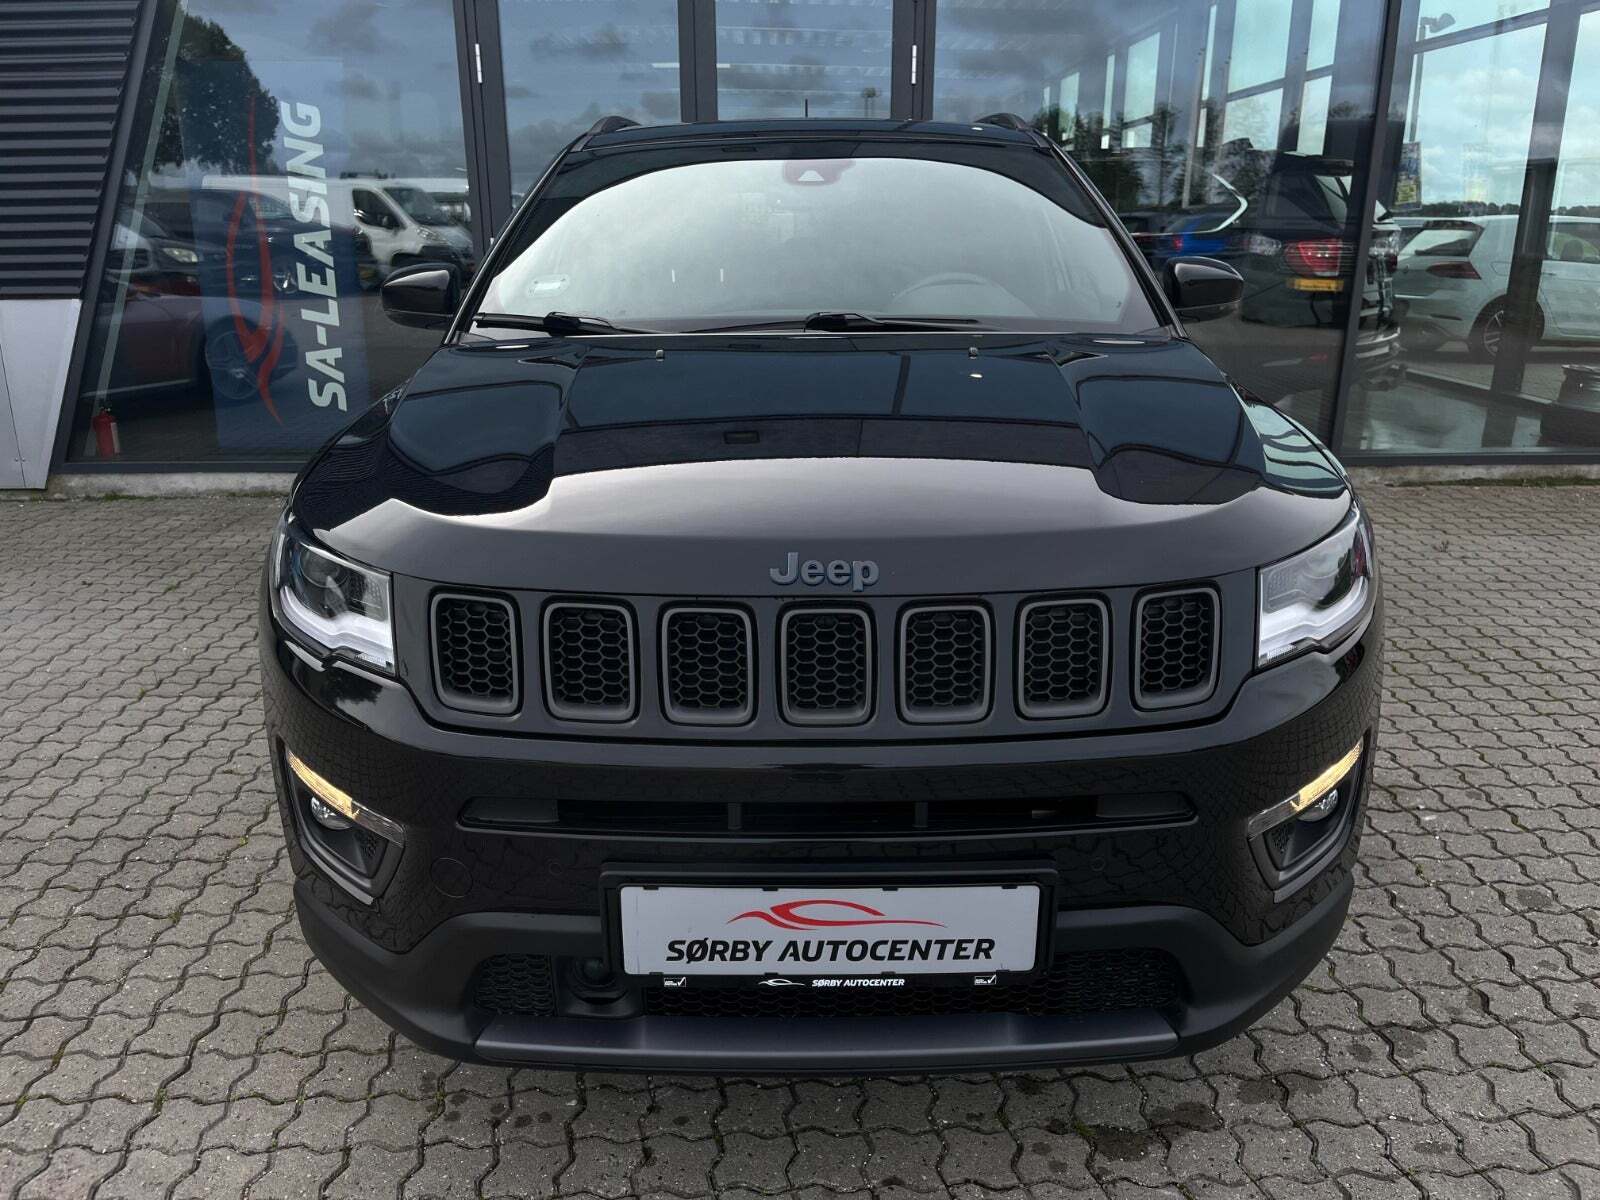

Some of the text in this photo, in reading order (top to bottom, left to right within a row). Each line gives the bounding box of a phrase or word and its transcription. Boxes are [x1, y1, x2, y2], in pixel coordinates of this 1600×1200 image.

[280, 101, 347, 412] SA-LEASING
[769, 552, 879, 592] Jeep
[665, 937, 995, 964] SØRBY AUTOCENTER
[812, 978, 906, 988] SØRBY AUTOCENTER
